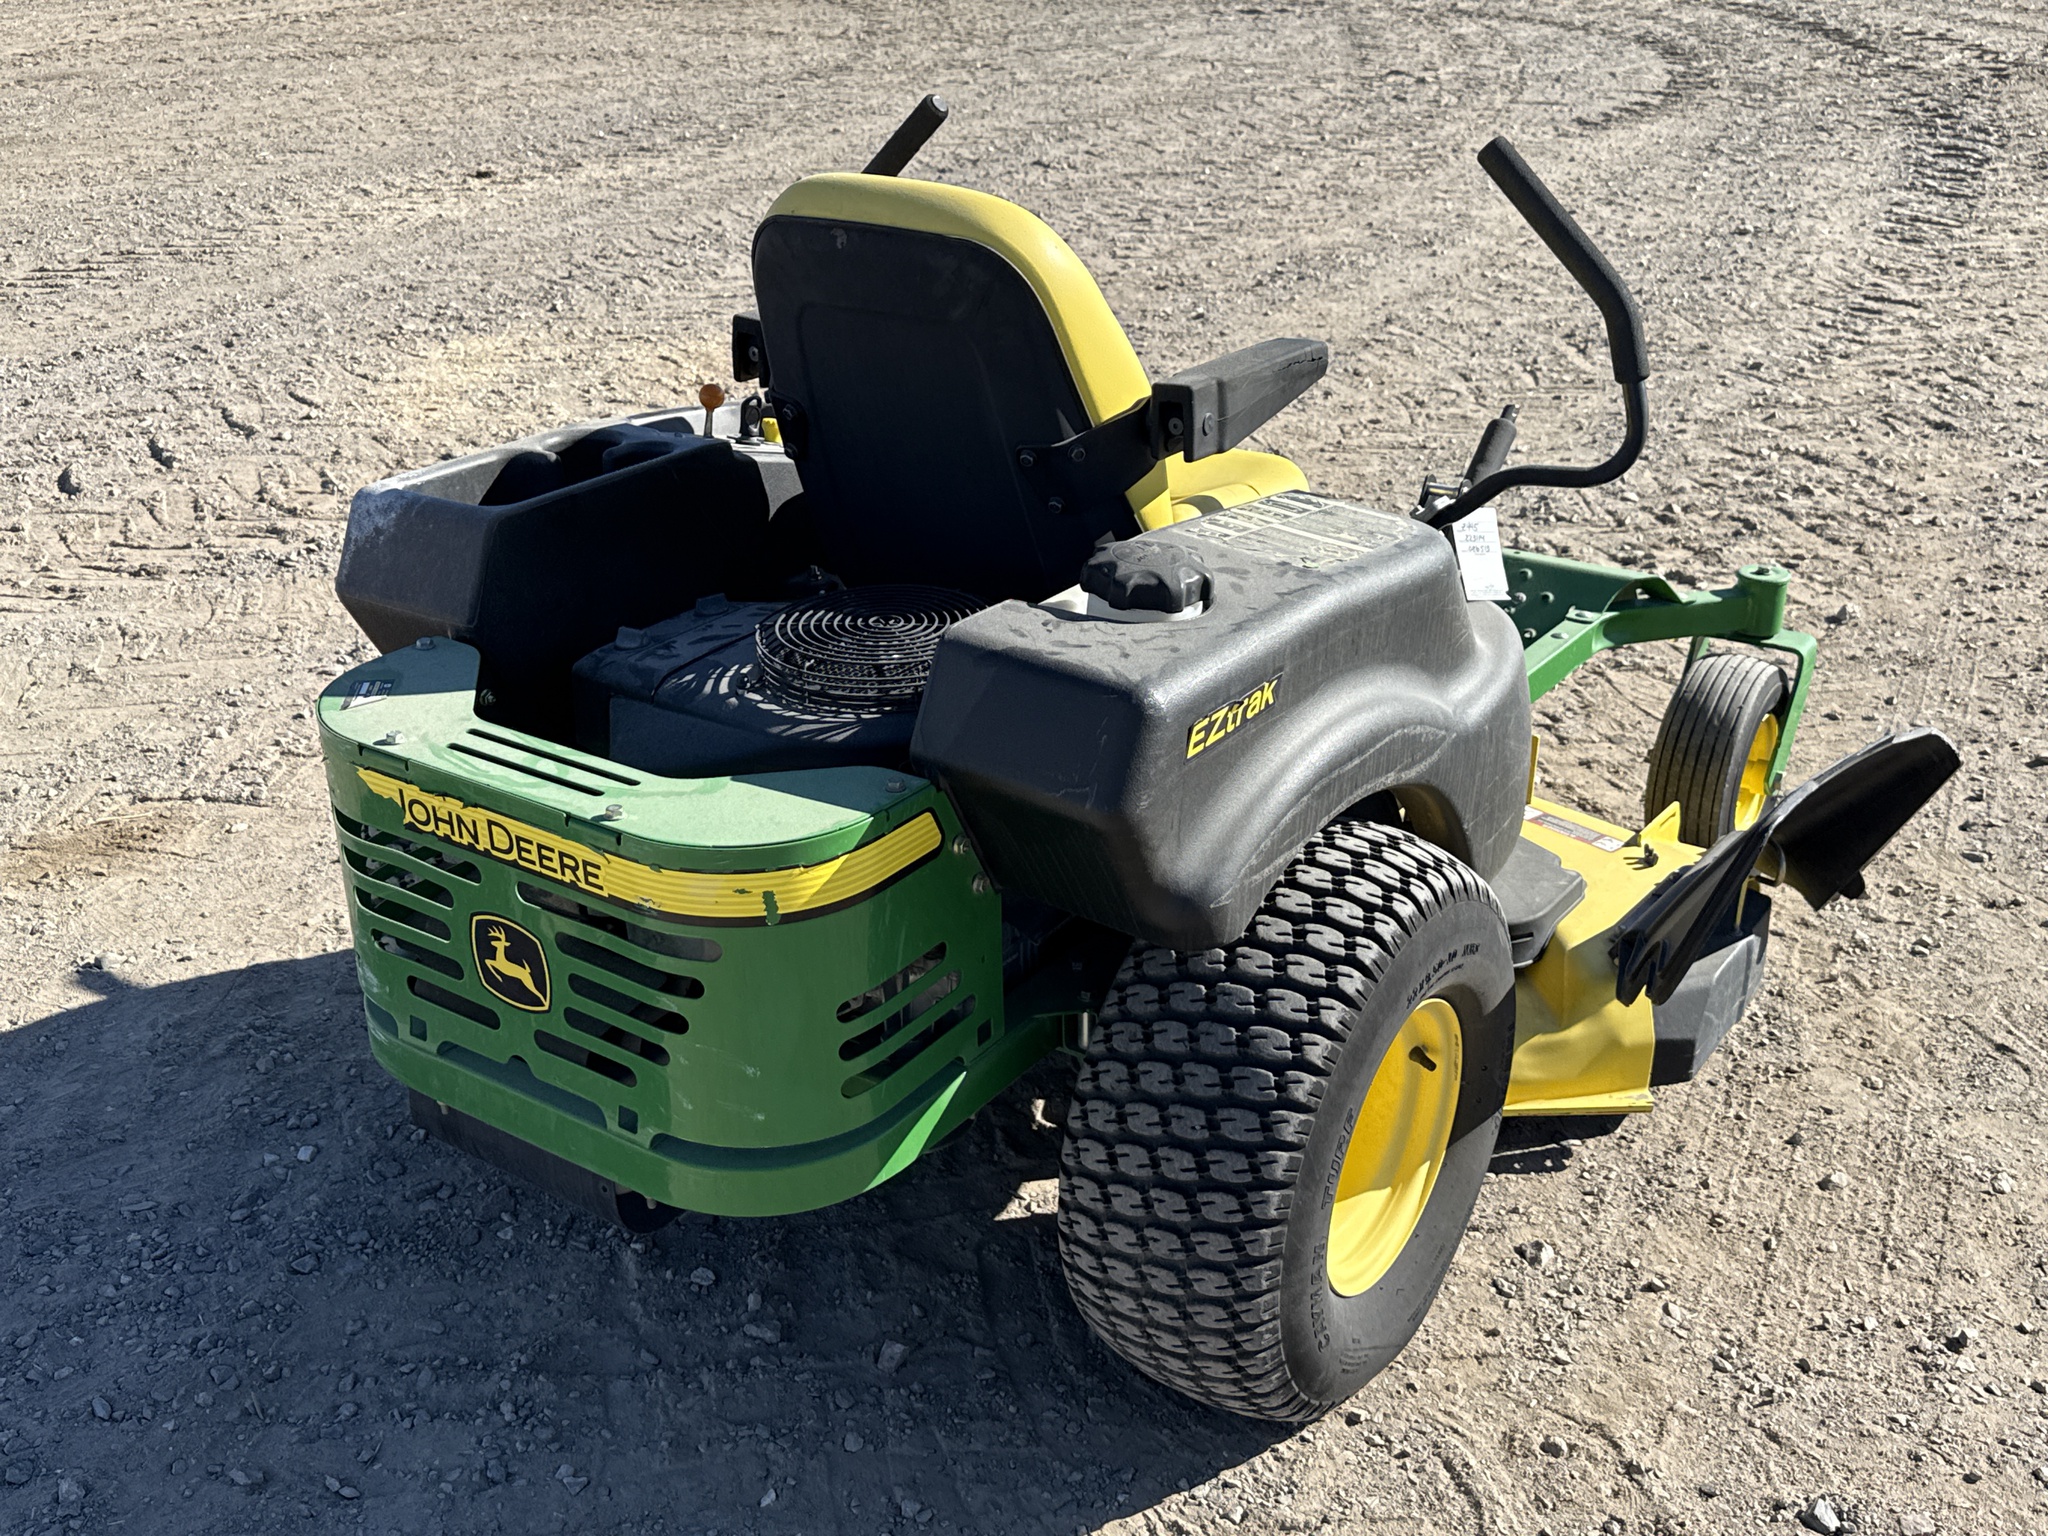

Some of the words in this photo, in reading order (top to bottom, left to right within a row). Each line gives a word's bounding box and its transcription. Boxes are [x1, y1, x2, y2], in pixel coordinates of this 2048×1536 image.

[1186, 679, 1278, 760] EZtrak
[398, 787, 481, 846] JOHN
[486, 817, 605, 893] DEERE
[1321, 1107, 1354, 1210] TURF
